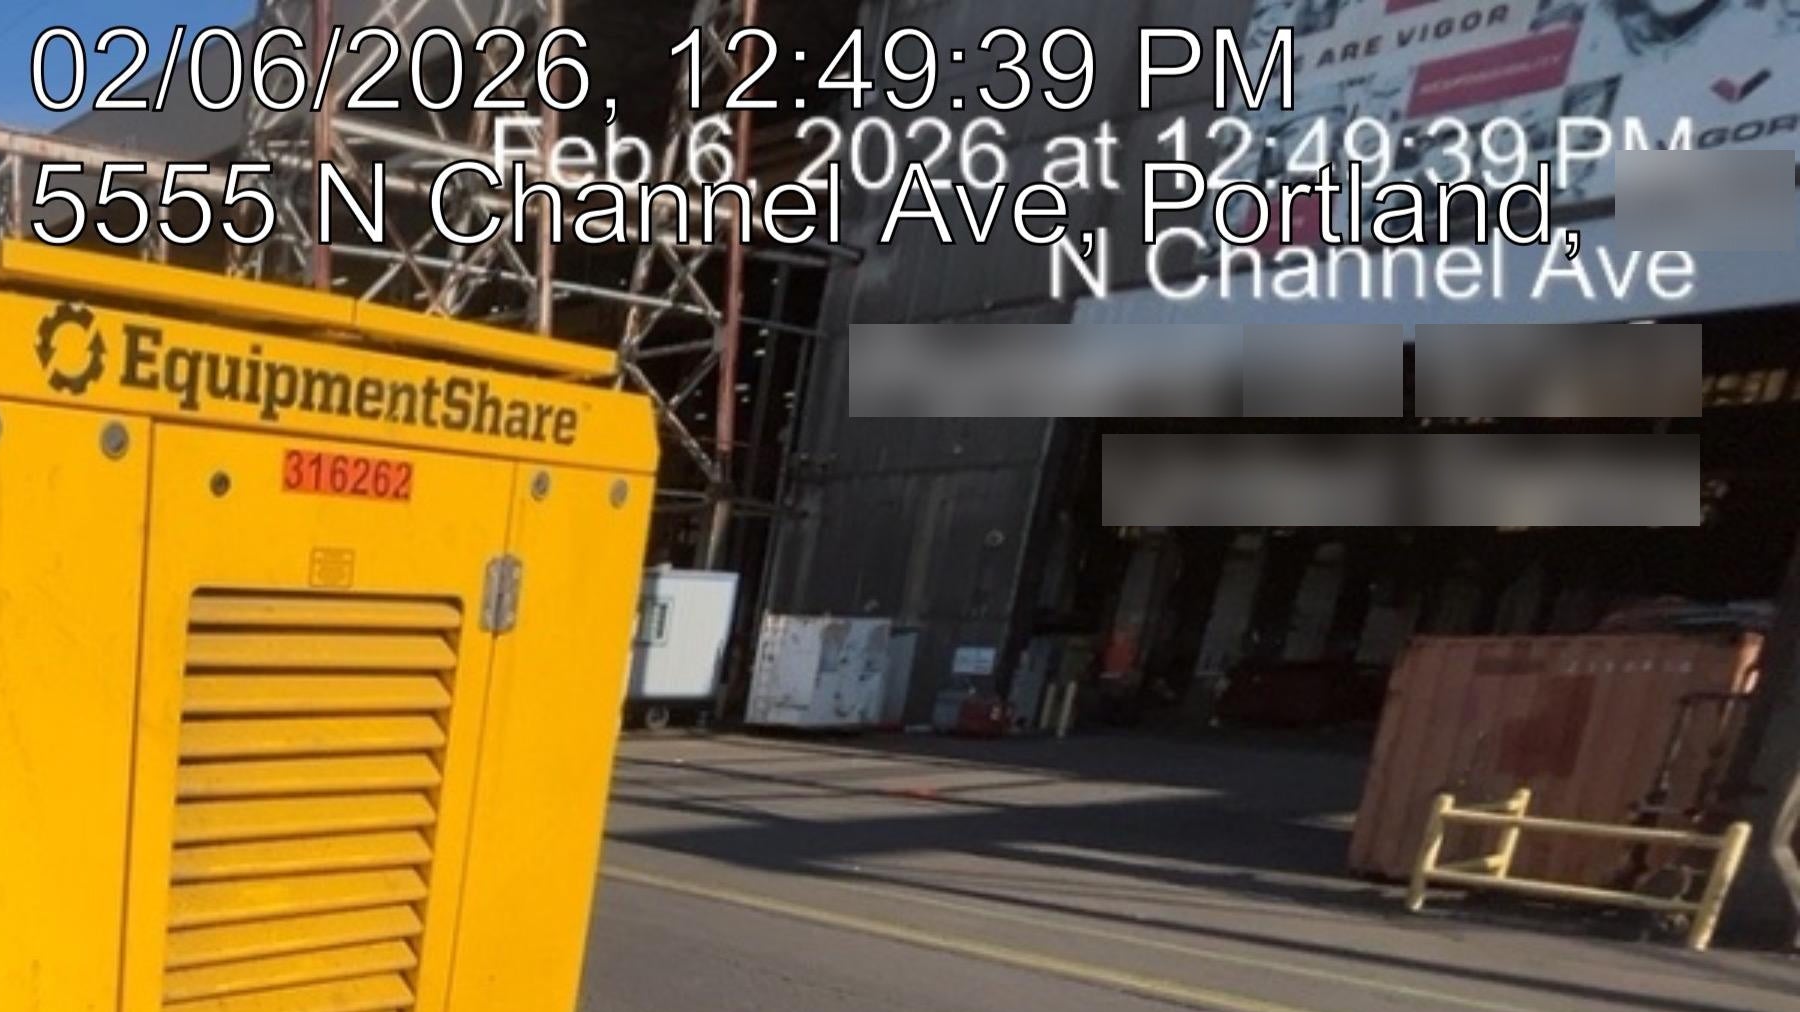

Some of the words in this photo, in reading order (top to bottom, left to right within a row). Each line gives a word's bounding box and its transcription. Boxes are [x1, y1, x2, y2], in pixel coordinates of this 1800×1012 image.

[1316, 35, 1383, 68] ARE
[1397, 4, 1510, 48] VIGOR
[120, 324, 578, 447] EquipmentShare
[283, 449, 413, 500] 316262
